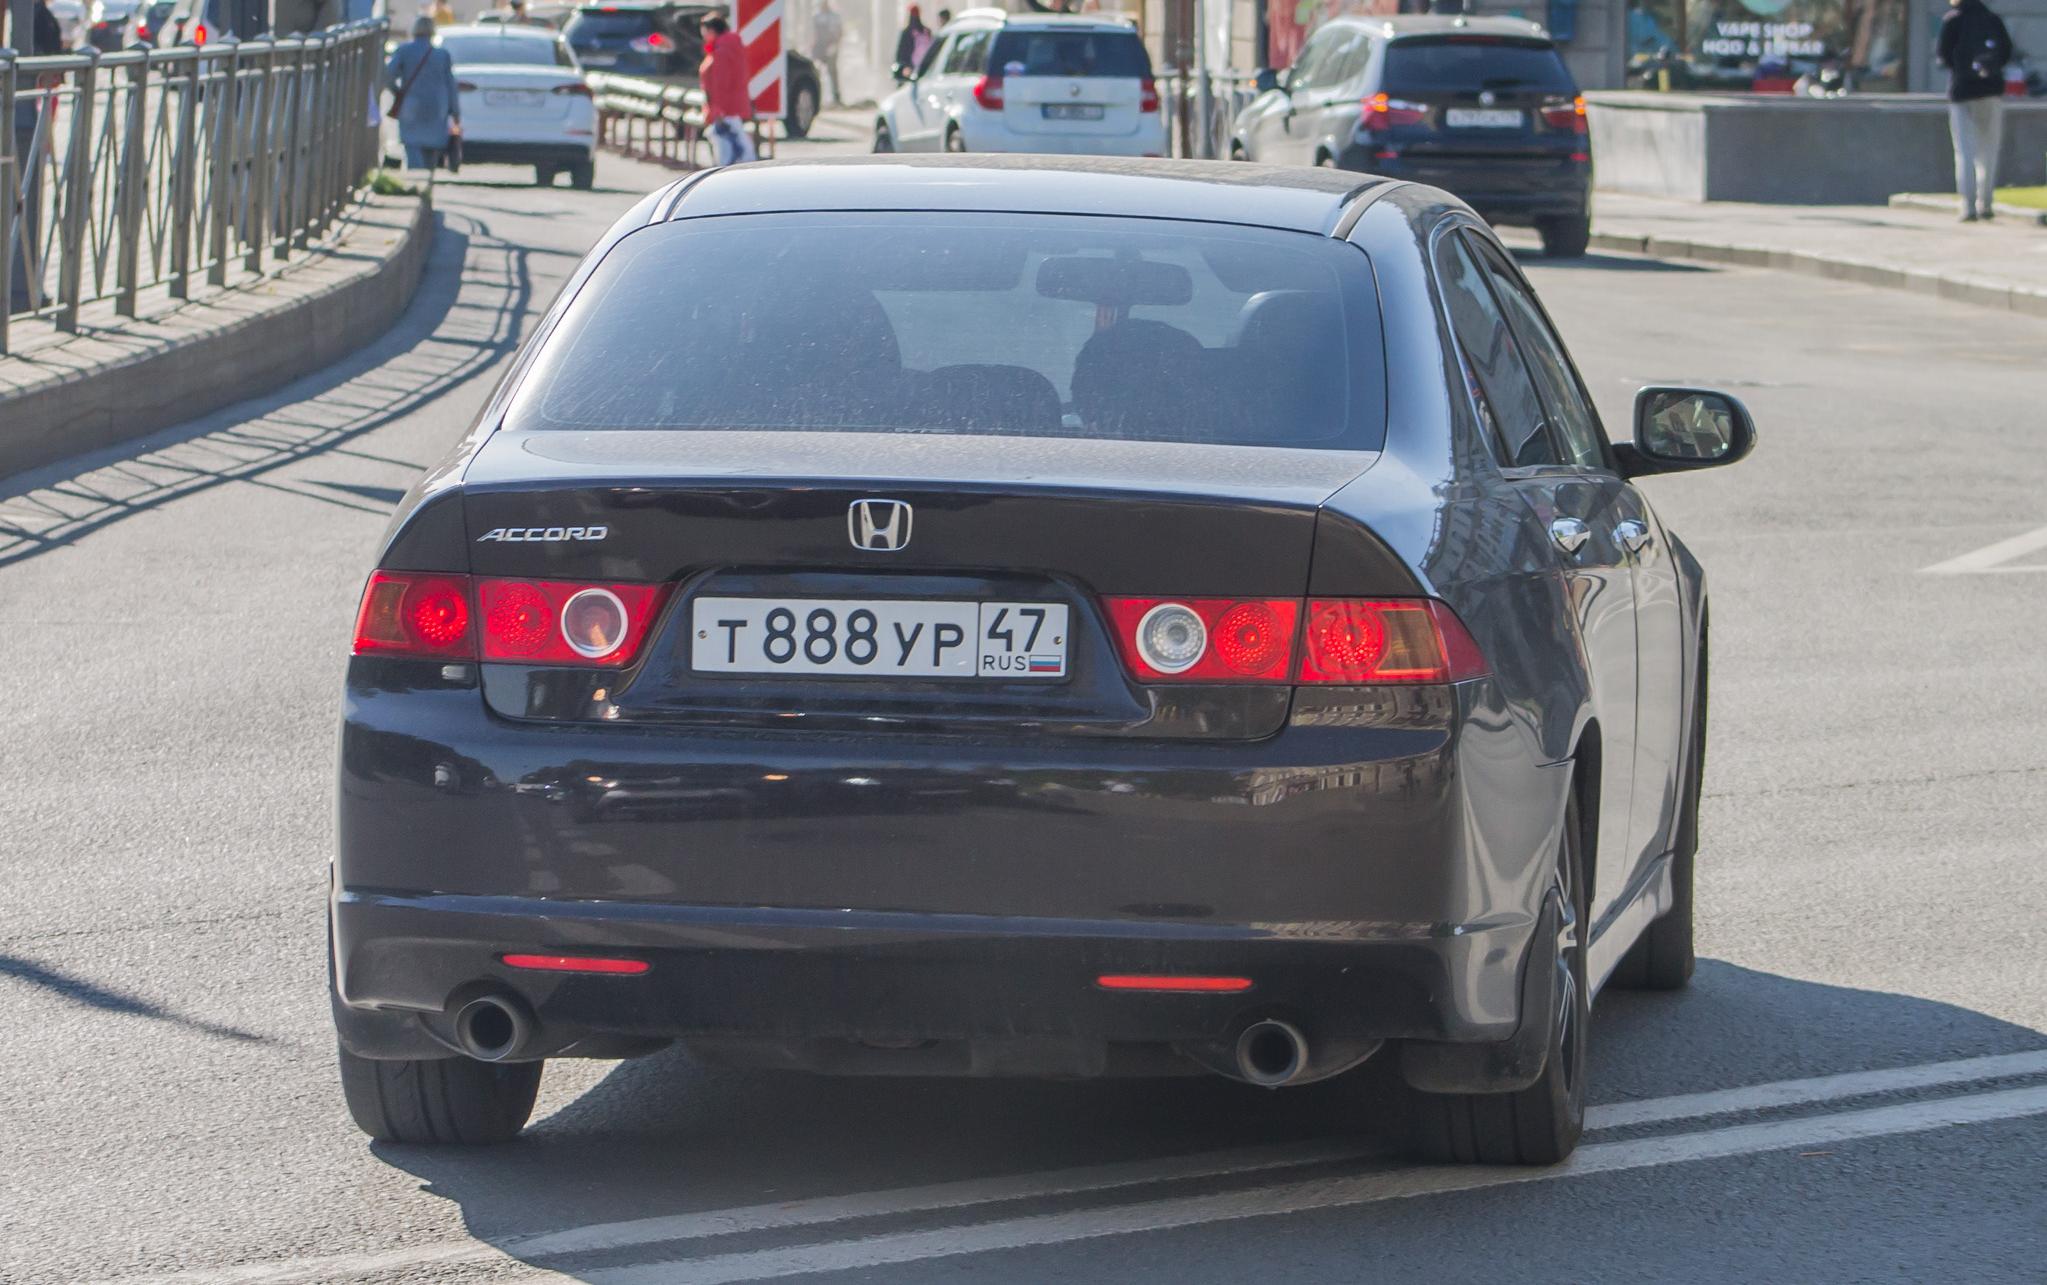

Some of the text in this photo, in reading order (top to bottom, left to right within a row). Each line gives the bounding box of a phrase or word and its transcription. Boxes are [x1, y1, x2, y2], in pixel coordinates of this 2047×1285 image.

[1716, 22, 1814, 38] VAPE SHOP
[476, 526, 608, 542] ACCORD
[987, 608, 1046, 653] 47
[983, 655, 1026, 671] RUS
